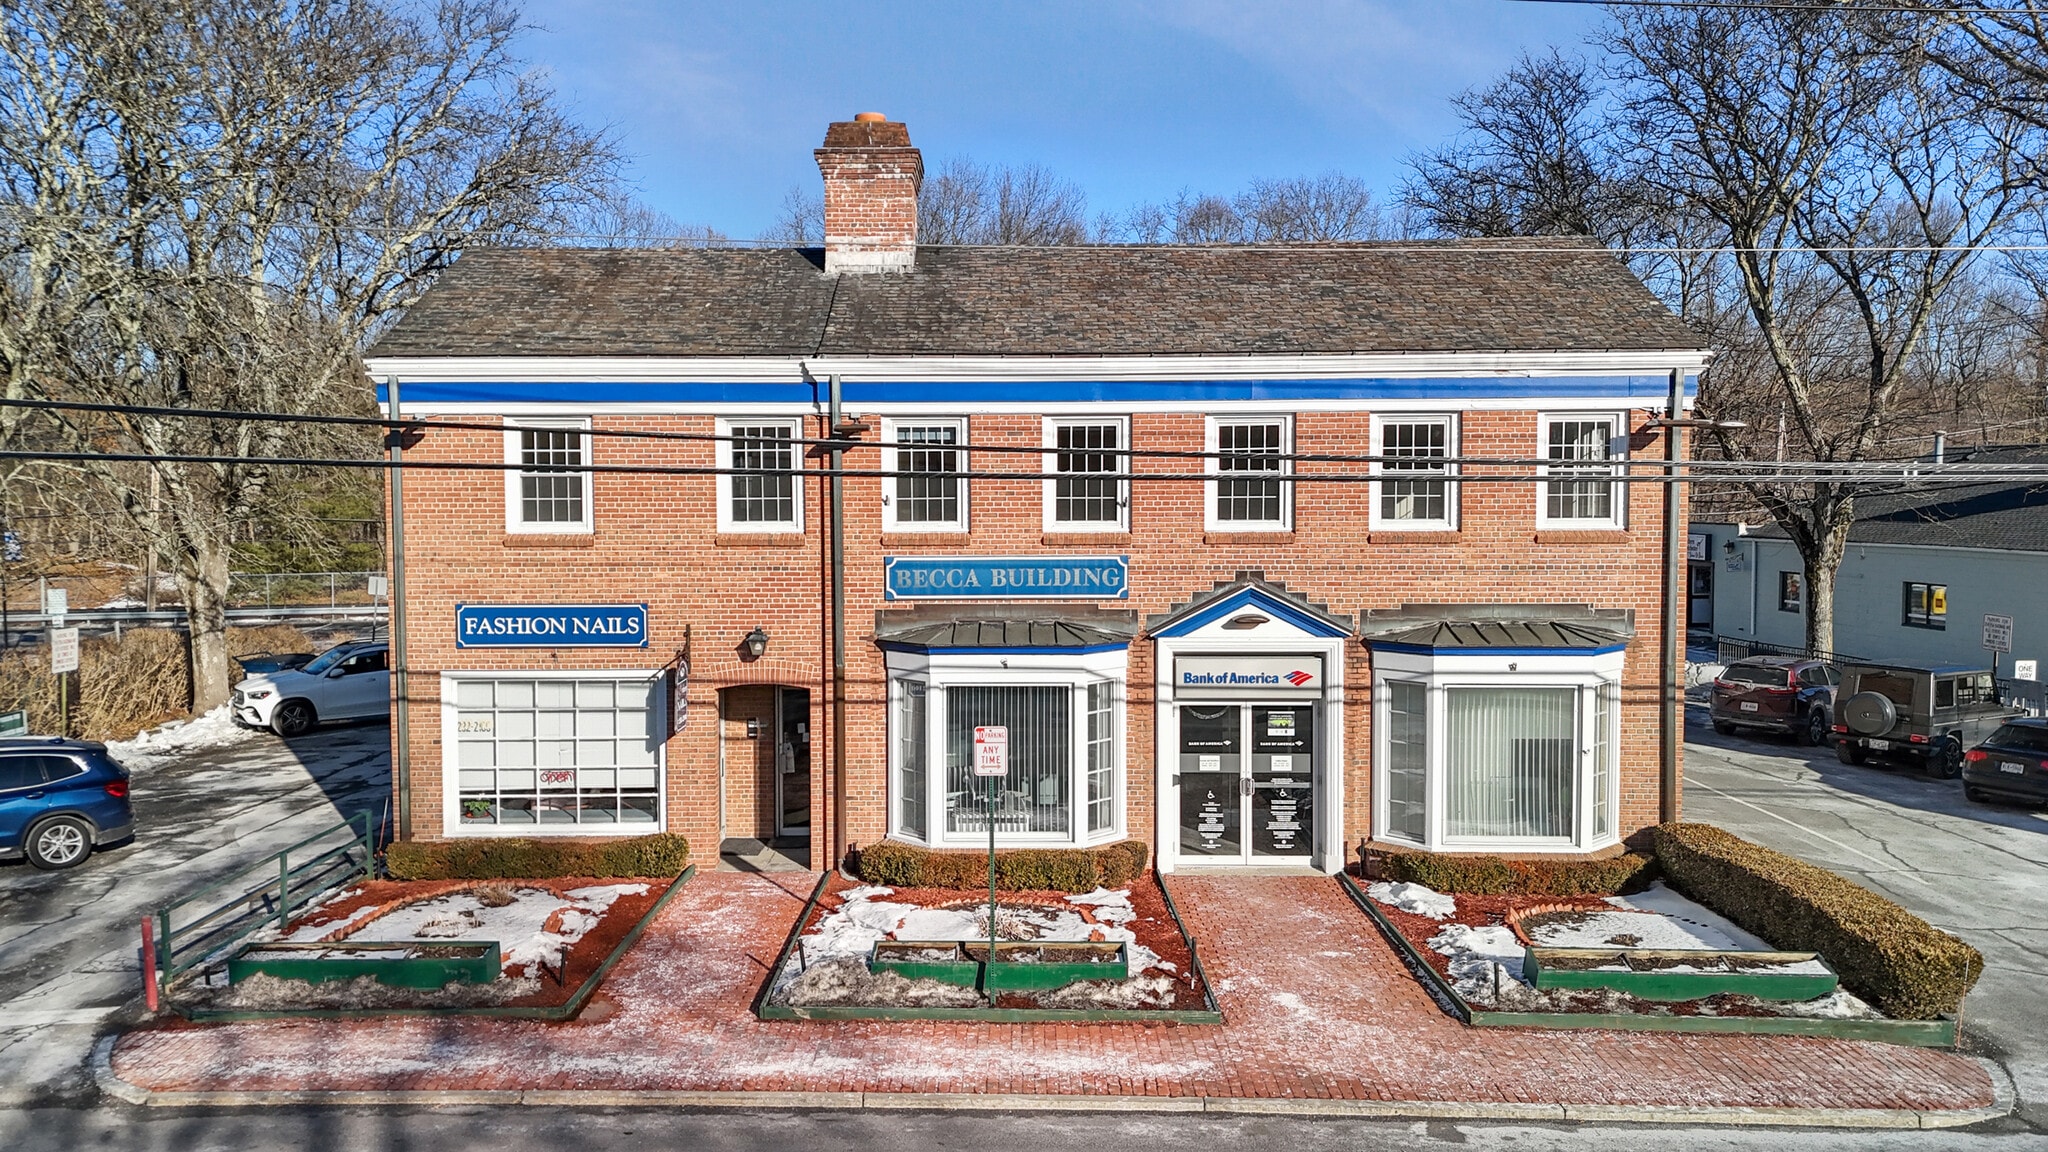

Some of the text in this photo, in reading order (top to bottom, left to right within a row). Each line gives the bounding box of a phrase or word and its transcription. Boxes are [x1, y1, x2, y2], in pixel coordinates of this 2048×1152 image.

[895, 567, 1120, 588] BECCA BUILDING
[465, 617, 639, 635] FASHION NAILS
[1183, 672, 1279, 684] Bank of America
[975, 730, 985, 741] NO
[983, 746, 999, 754] ANY
[981, 756, 1001, 764] TIME
